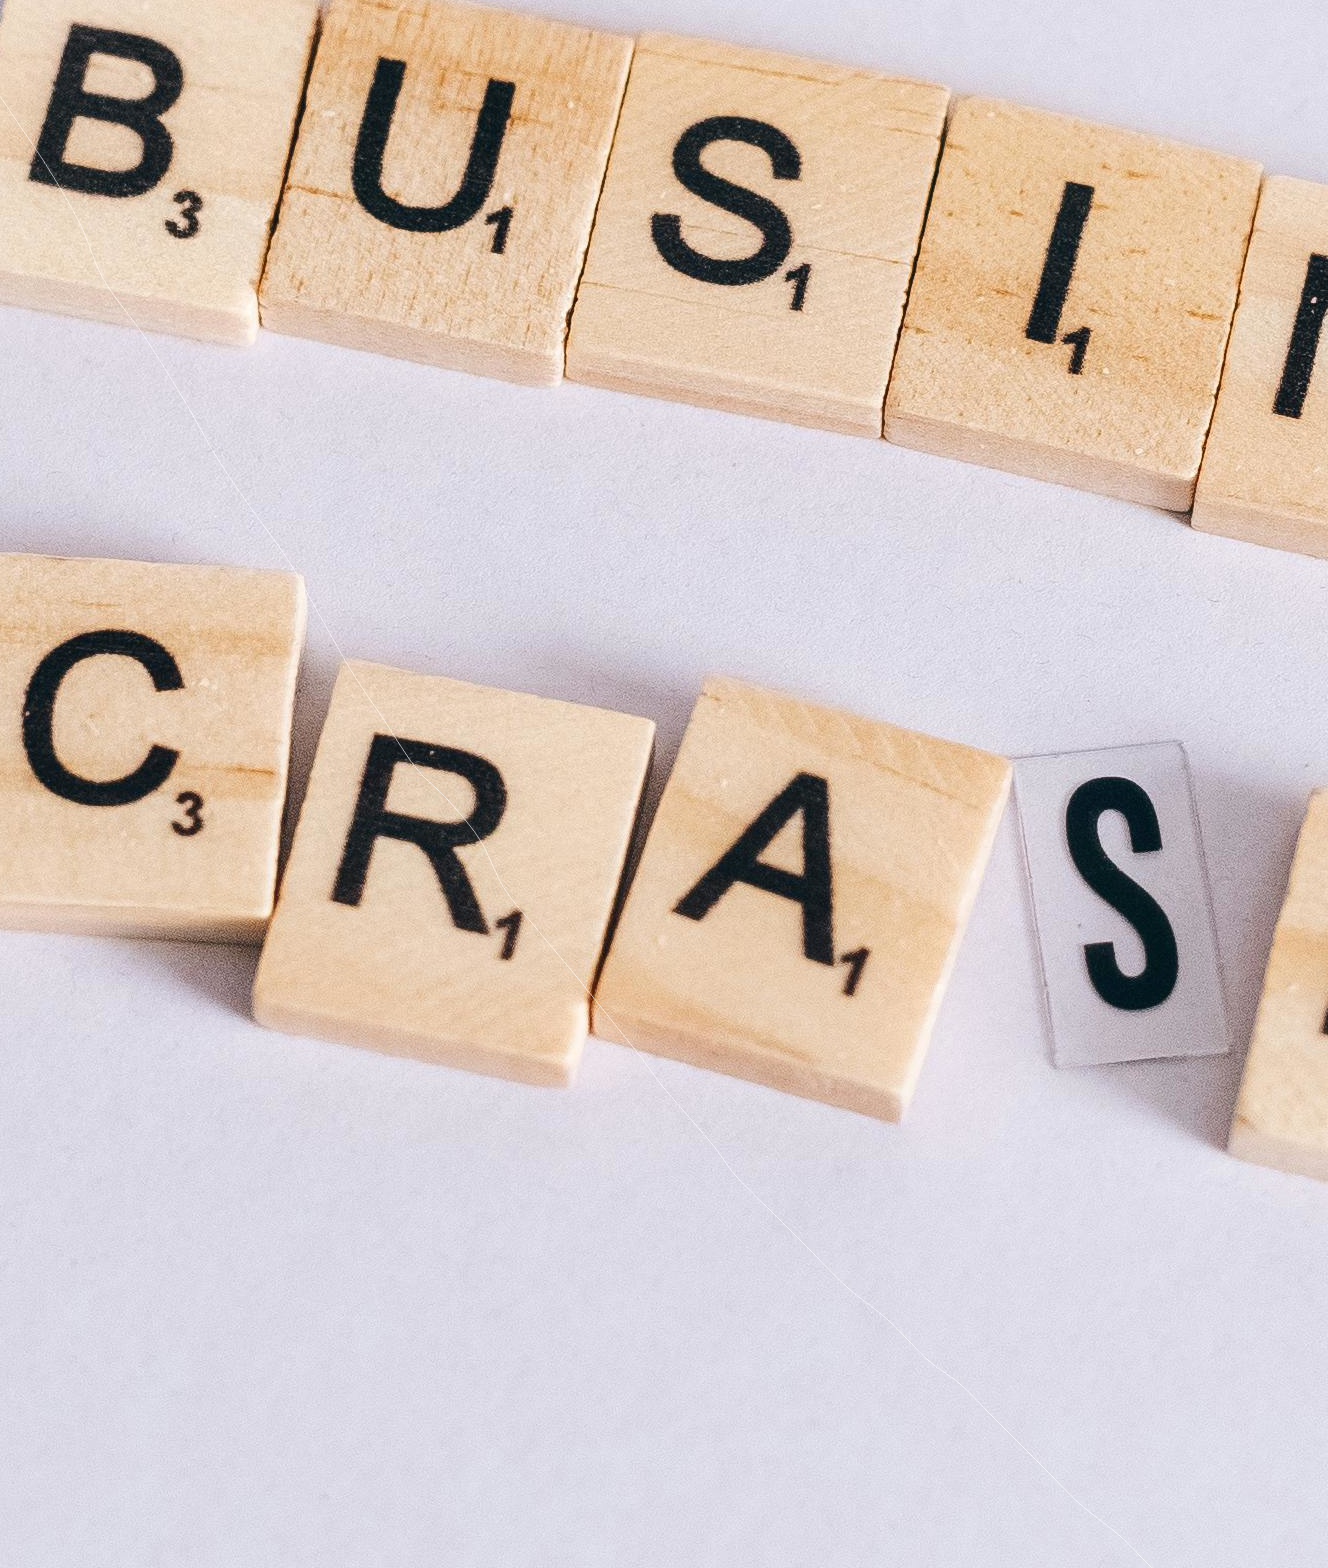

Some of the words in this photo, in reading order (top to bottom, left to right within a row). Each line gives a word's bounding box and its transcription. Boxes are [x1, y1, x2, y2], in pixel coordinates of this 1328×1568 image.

[165, 190, 203, 239] 3
[485, 206, 514, 255] 1
[784, 263, 811, 312] 1
[1061, 326, 1092, 374] 1
[171, 790, 204, 837] 3
[496, 910, 523, 960] 1
[840, 947, 870, 996] 1
